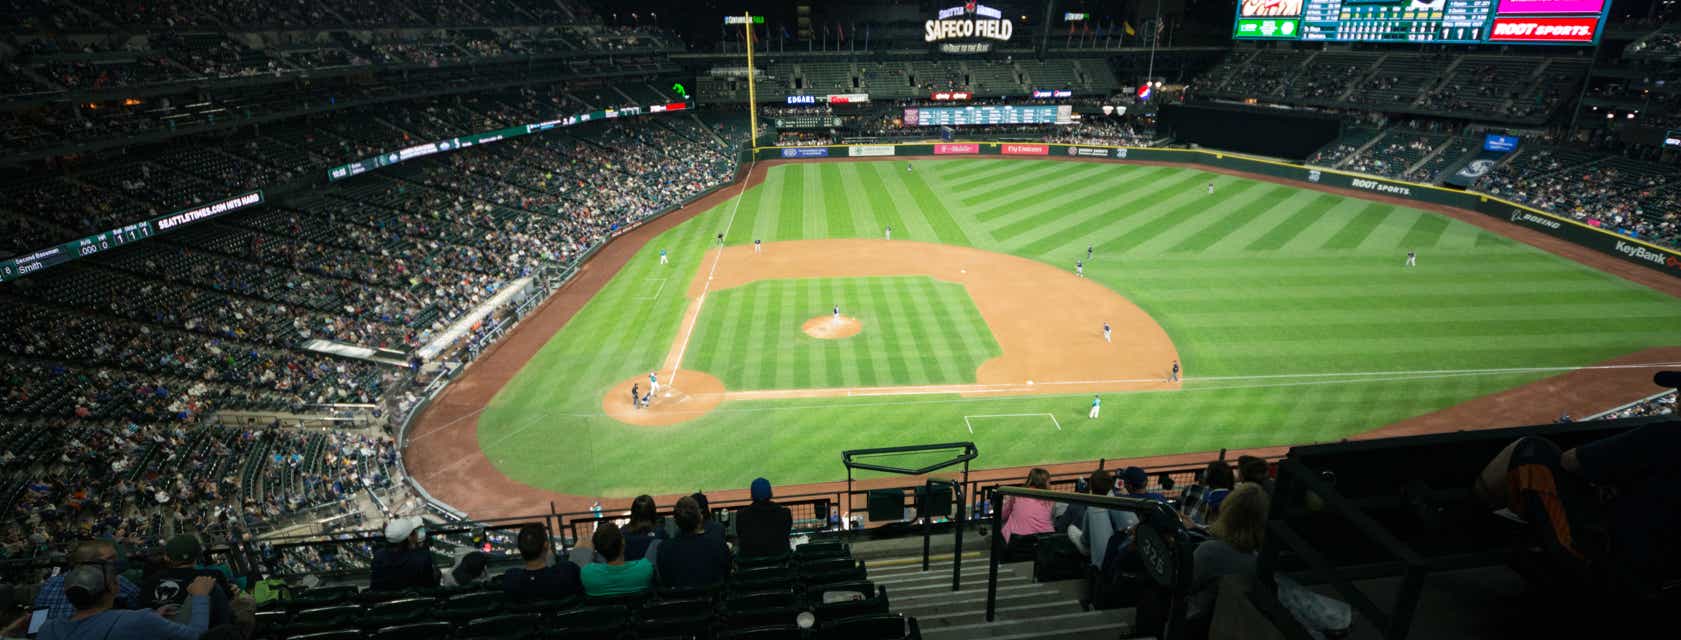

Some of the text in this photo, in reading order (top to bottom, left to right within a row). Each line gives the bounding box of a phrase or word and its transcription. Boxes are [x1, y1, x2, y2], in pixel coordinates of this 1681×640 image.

[925, 19, 1012, 42] SAFECO FIELD
[1442, 28, 1479, 39] 1 1 1
[1494, 23, 1537, 35] ROOT
[787, 95, 815, 104] EDGARS
[1352, 178, 1410, 195] ROOT SPORTS
[158, 193, 259, 229] SEATTLETIMES.COM HITS HARD
[1523, 213, 1560, 229] BOEING
[118, 227, 148, 244] 1 1 1
[1615, 240, 1666, 264] KeyBank
[18, 261, 43, 274] Smith
